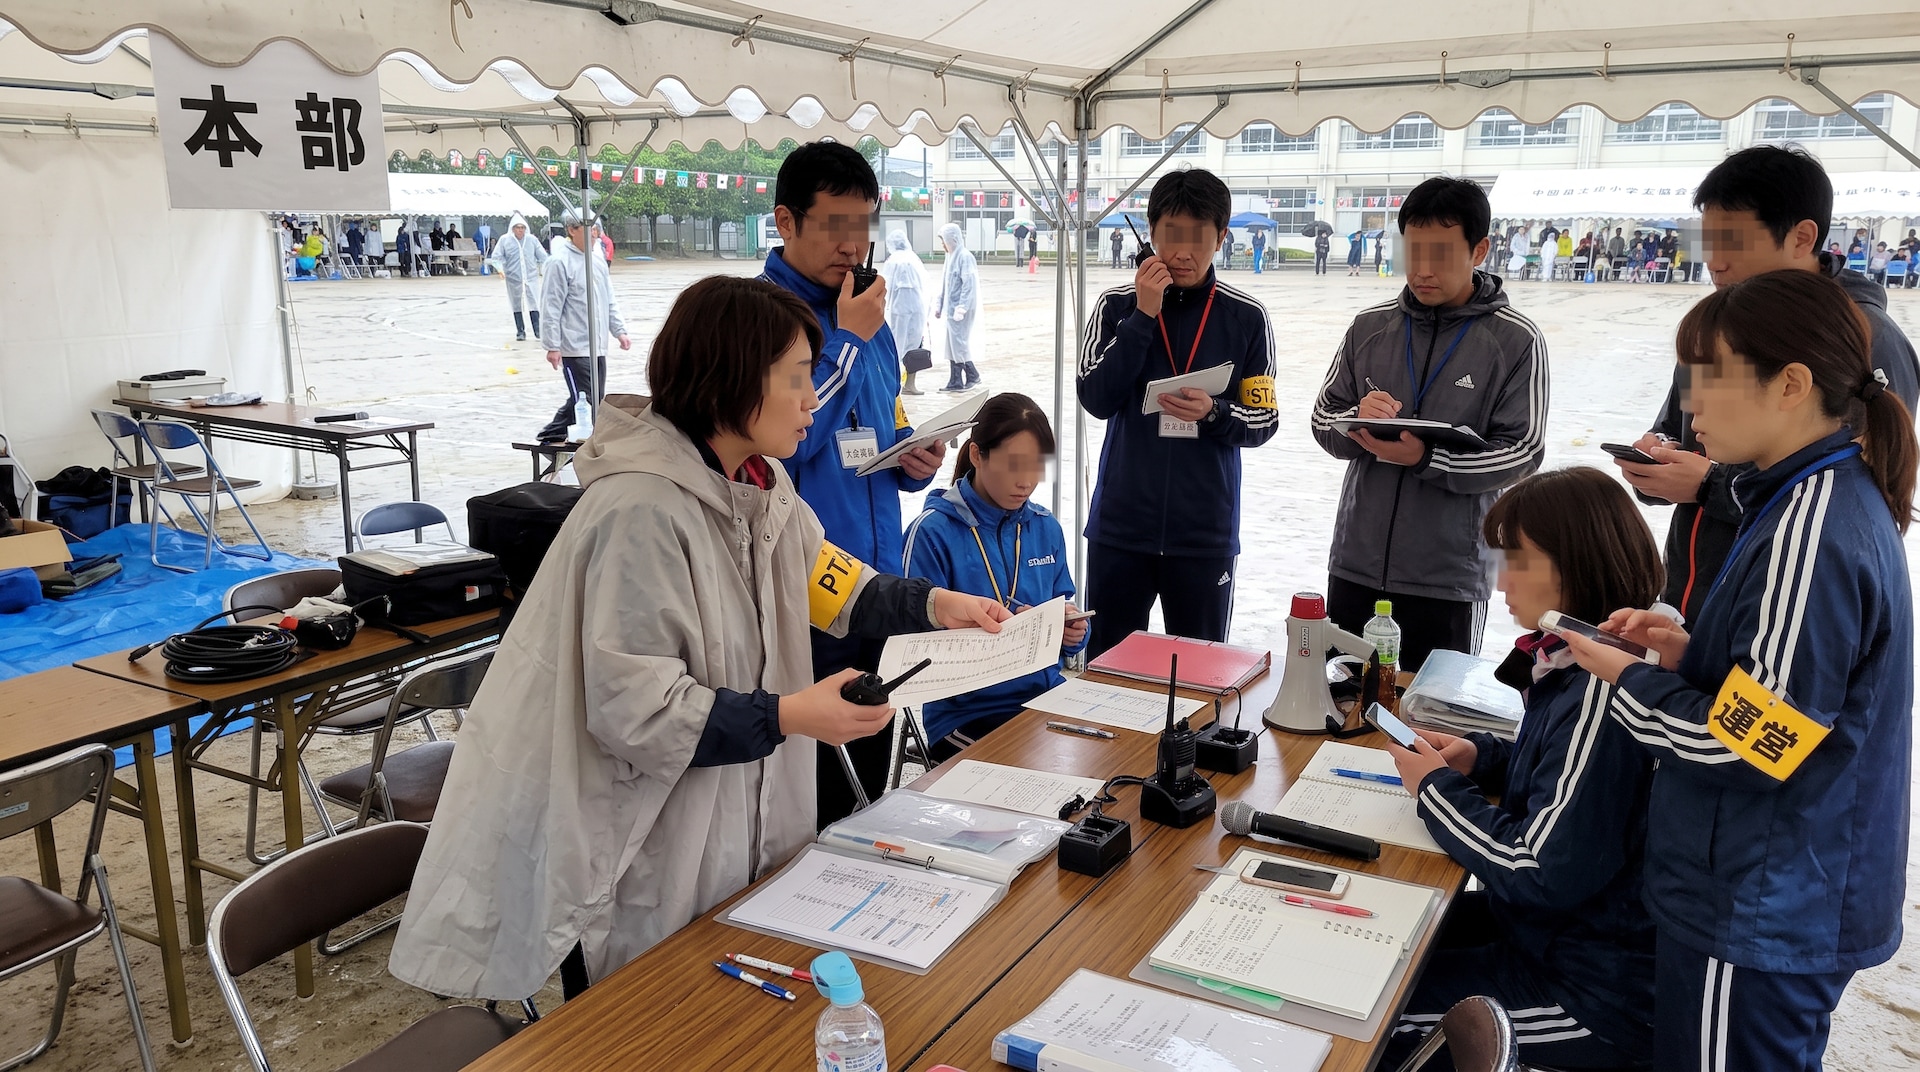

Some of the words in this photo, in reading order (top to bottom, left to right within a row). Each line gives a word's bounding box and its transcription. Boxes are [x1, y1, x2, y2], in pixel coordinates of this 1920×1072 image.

[180, 84, 365, 172] 本部
[817, 550, 854, 596] PTA
[1713, 691, 1799, 764] 運営
